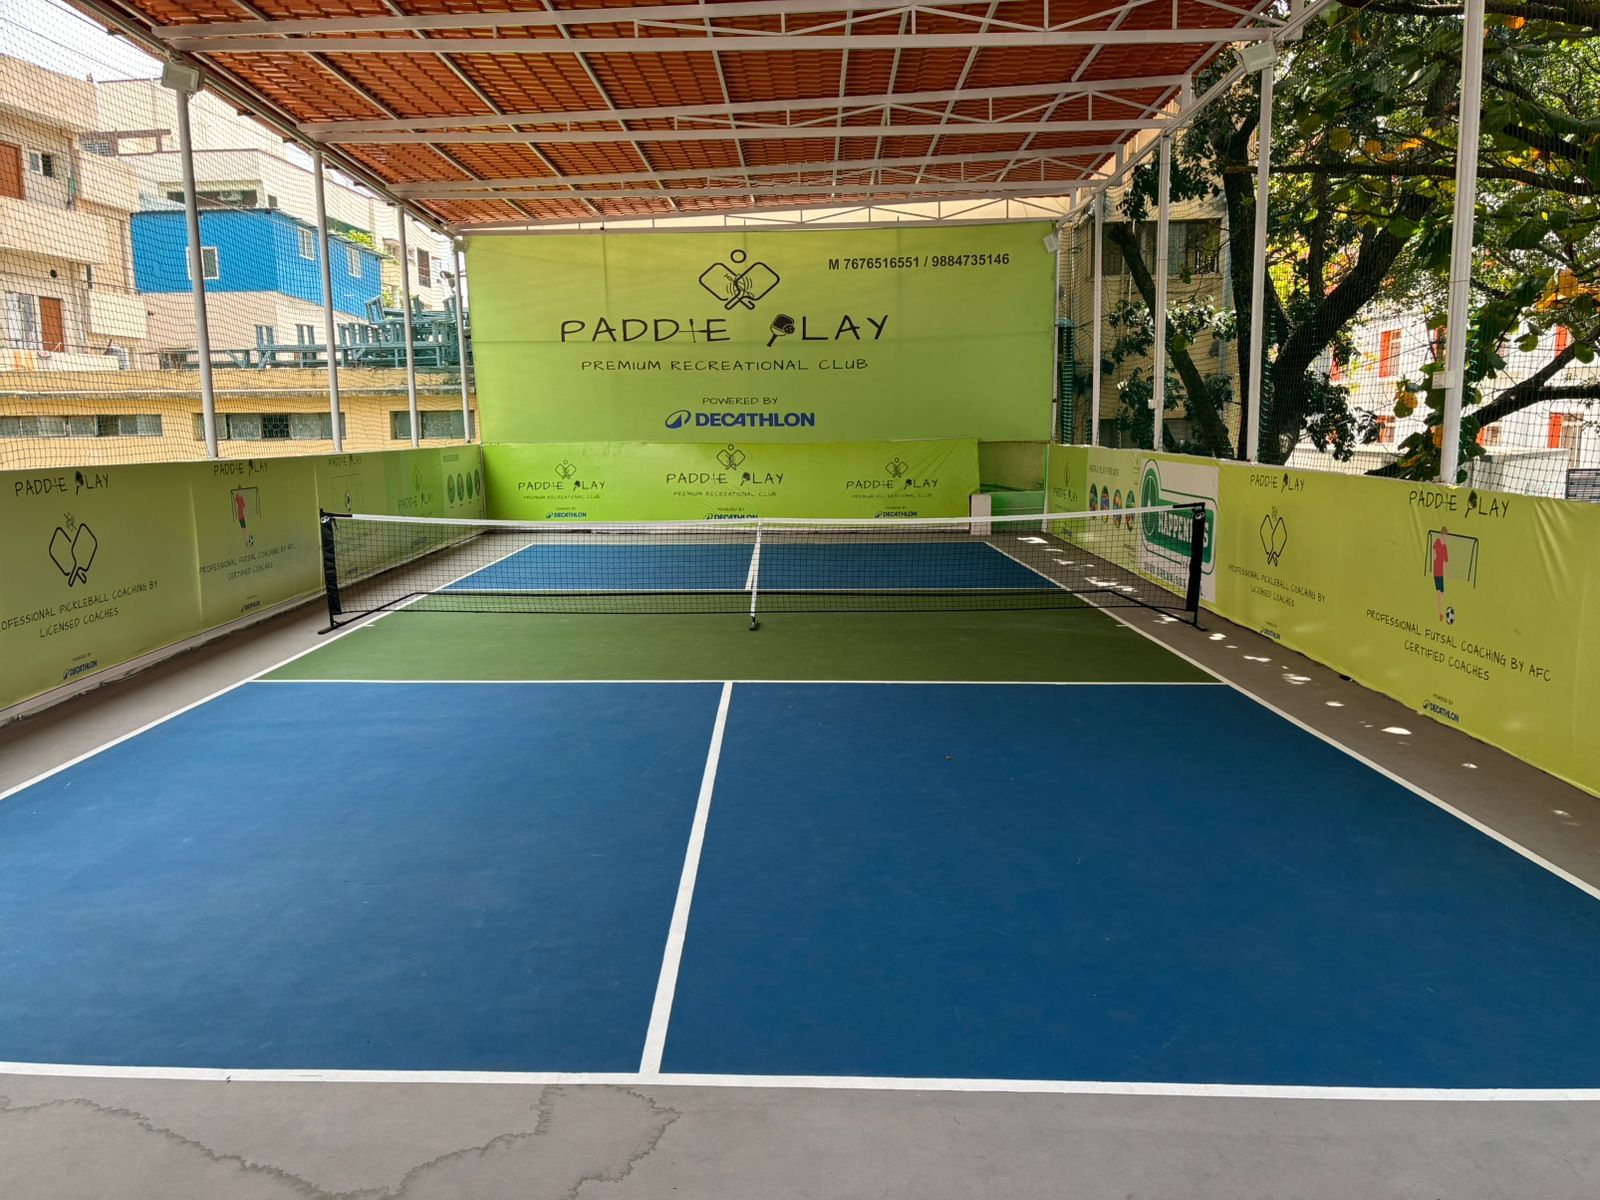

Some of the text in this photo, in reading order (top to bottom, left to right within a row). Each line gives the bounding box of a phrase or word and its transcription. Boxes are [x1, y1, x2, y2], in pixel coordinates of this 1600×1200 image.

[829, 254, 1010, 270] M 7676516551 / 9884735146
[582, 358, 868, 372] PREMIUM RECREATIONAL CLUB
[702, 396, 778, 405] POWERED BY
[695, 412, 815, 428] DECATHLON
[1158, 508, 1209, 548] HAPPENIS
[200, 560, 237, 574] PROFESSIONAL
[1261, 574, 1289, 590] PICKLEBALL
[1318, 592, 1325, 602] BY
[0, 581, 158, 632] OFESSIONAL PICKLEBALL COACHING BY
[40, 607, 118, 638] LICENSED COACHES
[1366, 609, 1551, 681] PROFESSIONAL FUTSAL COACHING BY AFC
[70, 660, 98, 677] DECATHLON
[1404, 640, 1490, 681] CERTIFIED COACHES
[1430, 702, 1459, 722] DECATHLON
